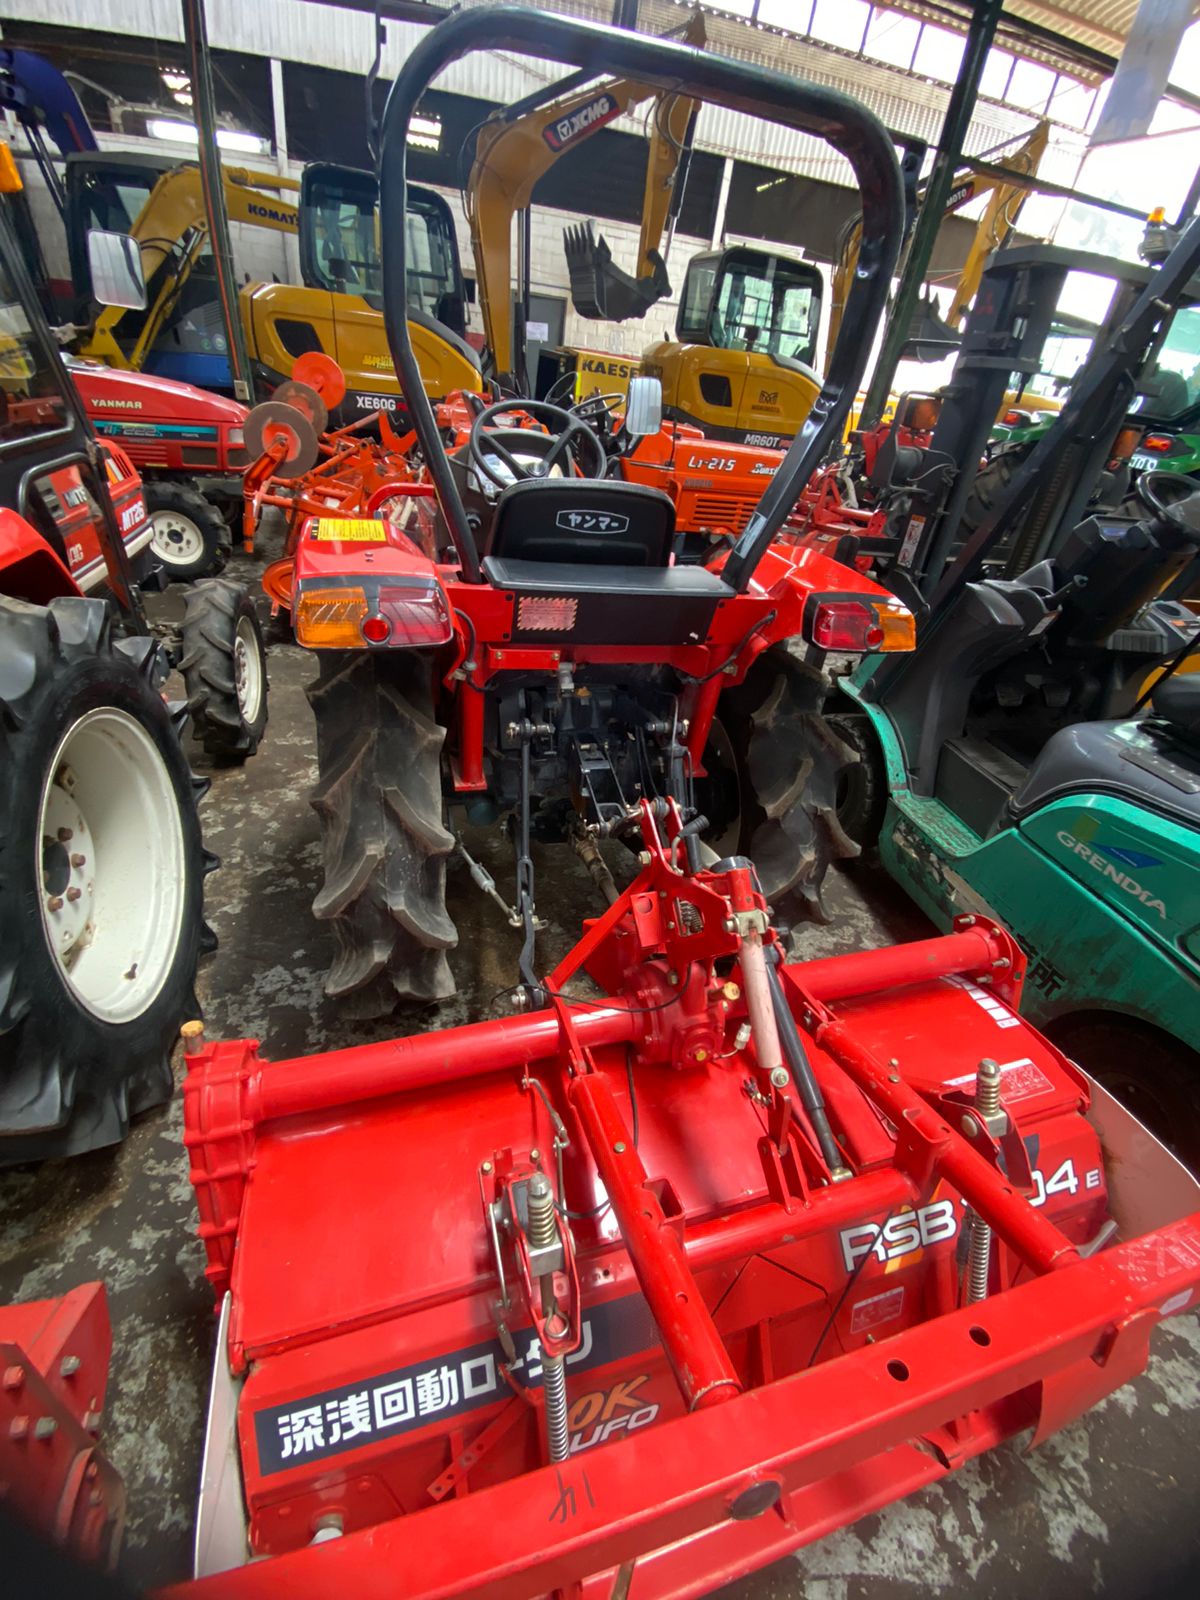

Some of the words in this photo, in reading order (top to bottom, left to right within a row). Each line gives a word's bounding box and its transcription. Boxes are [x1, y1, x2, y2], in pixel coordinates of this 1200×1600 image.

[571, 97, 609, 134] XCMG
[946, 189, 967, 207] MOTO
[91, 399, 142, 409] YANMAR
[356, 395, 396, 410] XE60G
[744, 434, 779, 447] MR60T
[569, 513, 618, 530] ヤンマー
[1056, 831, 1166, 919] GRENDIA
[840, 1199, 957, 1272] RSB
[567, 1375, 649, 1431] OK
[570, 1404, 659, 1453] UFO
